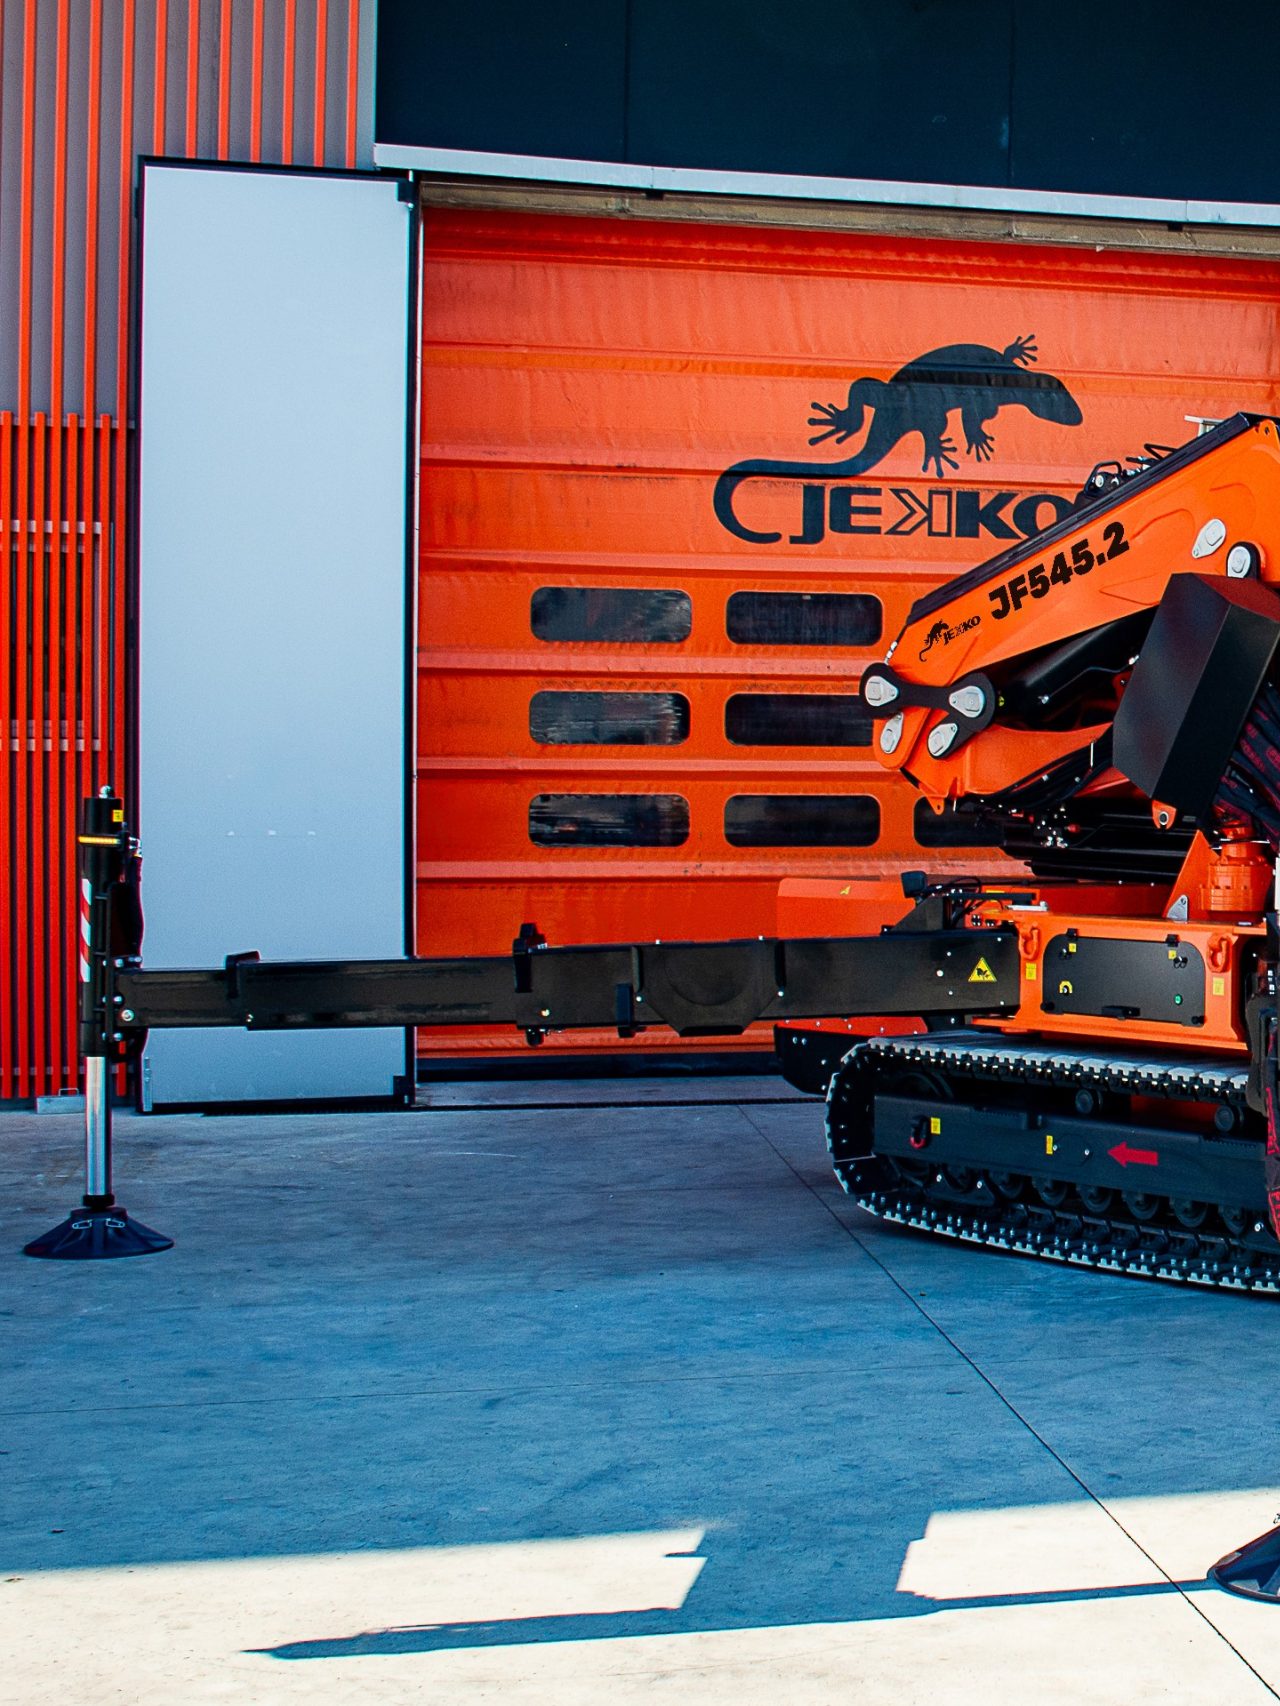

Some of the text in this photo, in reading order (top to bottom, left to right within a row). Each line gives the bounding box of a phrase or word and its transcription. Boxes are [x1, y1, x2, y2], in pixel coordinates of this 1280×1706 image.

[788, 483, 1077, 545] JEKKO
[988, 521, 1130, 620] JF545.2
[943, 615, 982, 646] JEKKO
